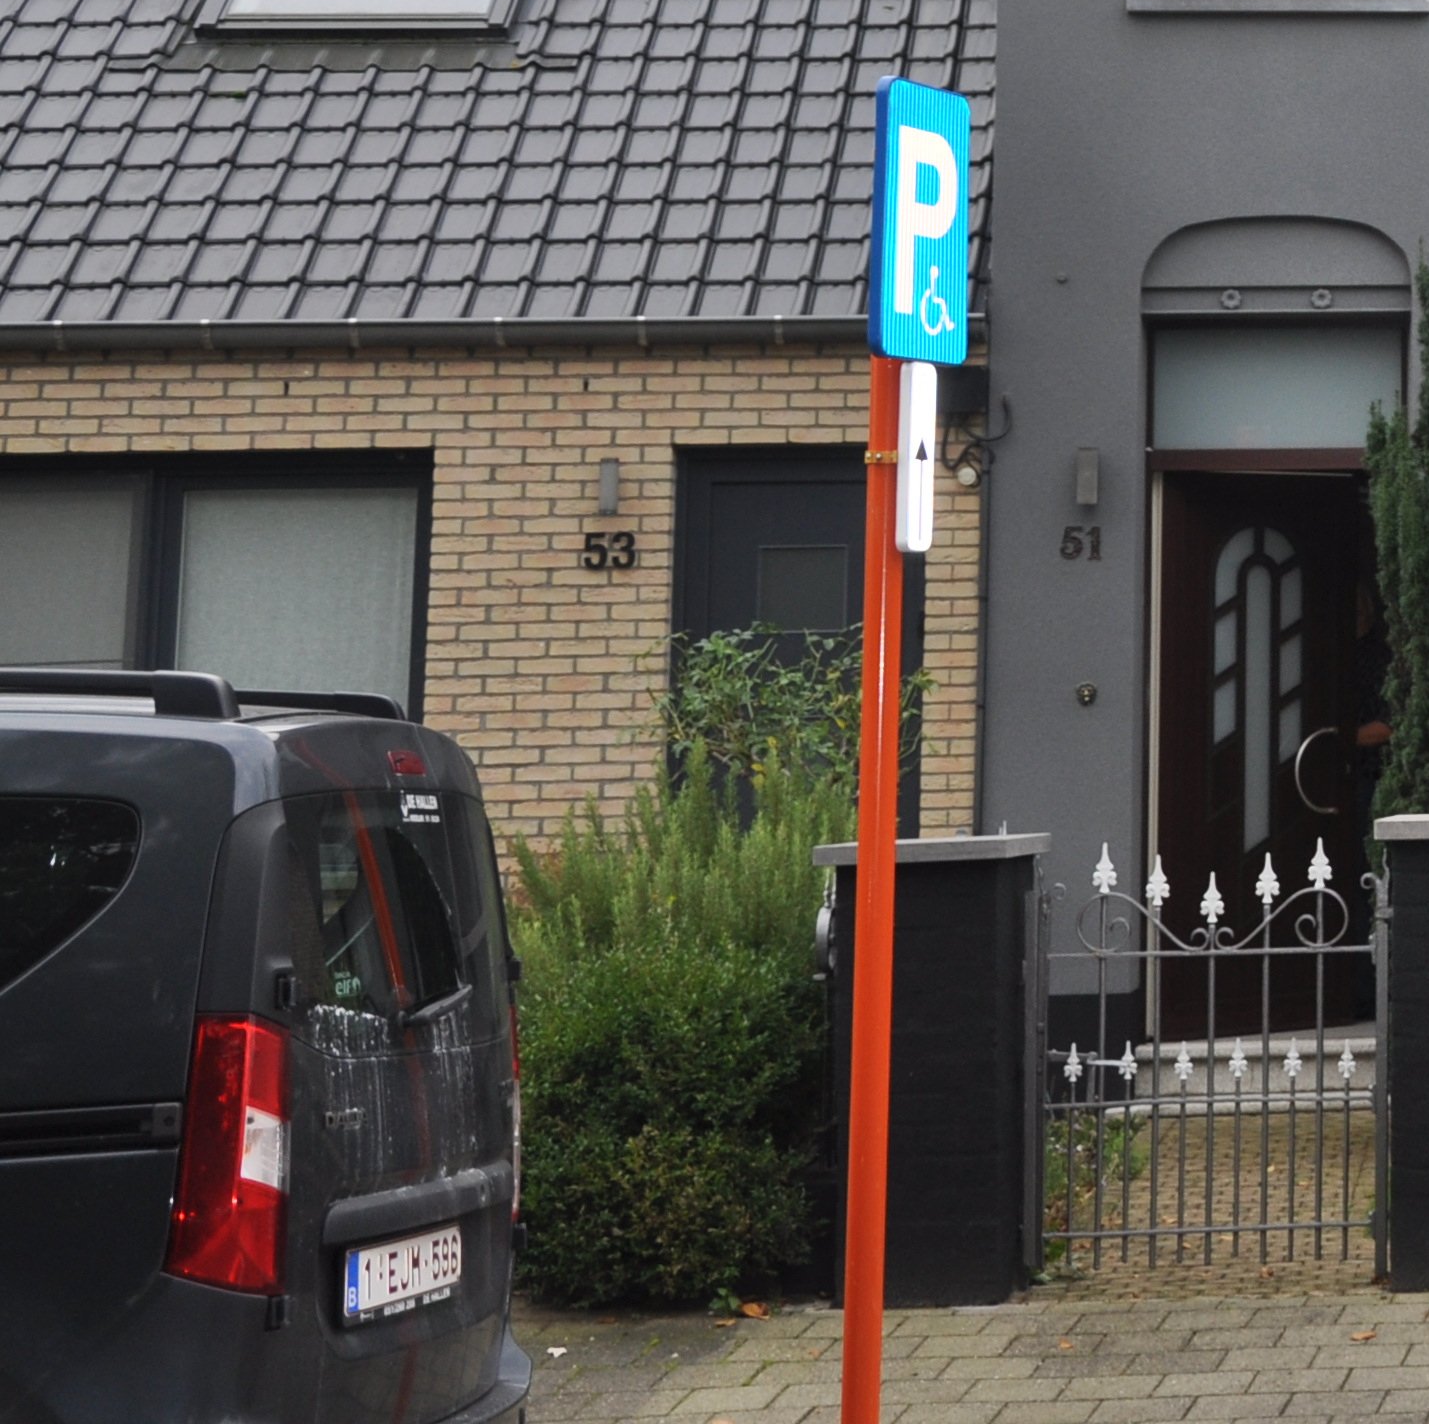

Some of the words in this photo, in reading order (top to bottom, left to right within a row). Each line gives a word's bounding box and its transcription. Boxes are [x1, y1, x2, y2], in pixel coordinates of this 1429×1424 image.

[894, 125, 959, 315] P
[584, 531, 636, 571] 53
[1060, 526, 1102, 561] 51
[348, 1286, 358, 1308] B
